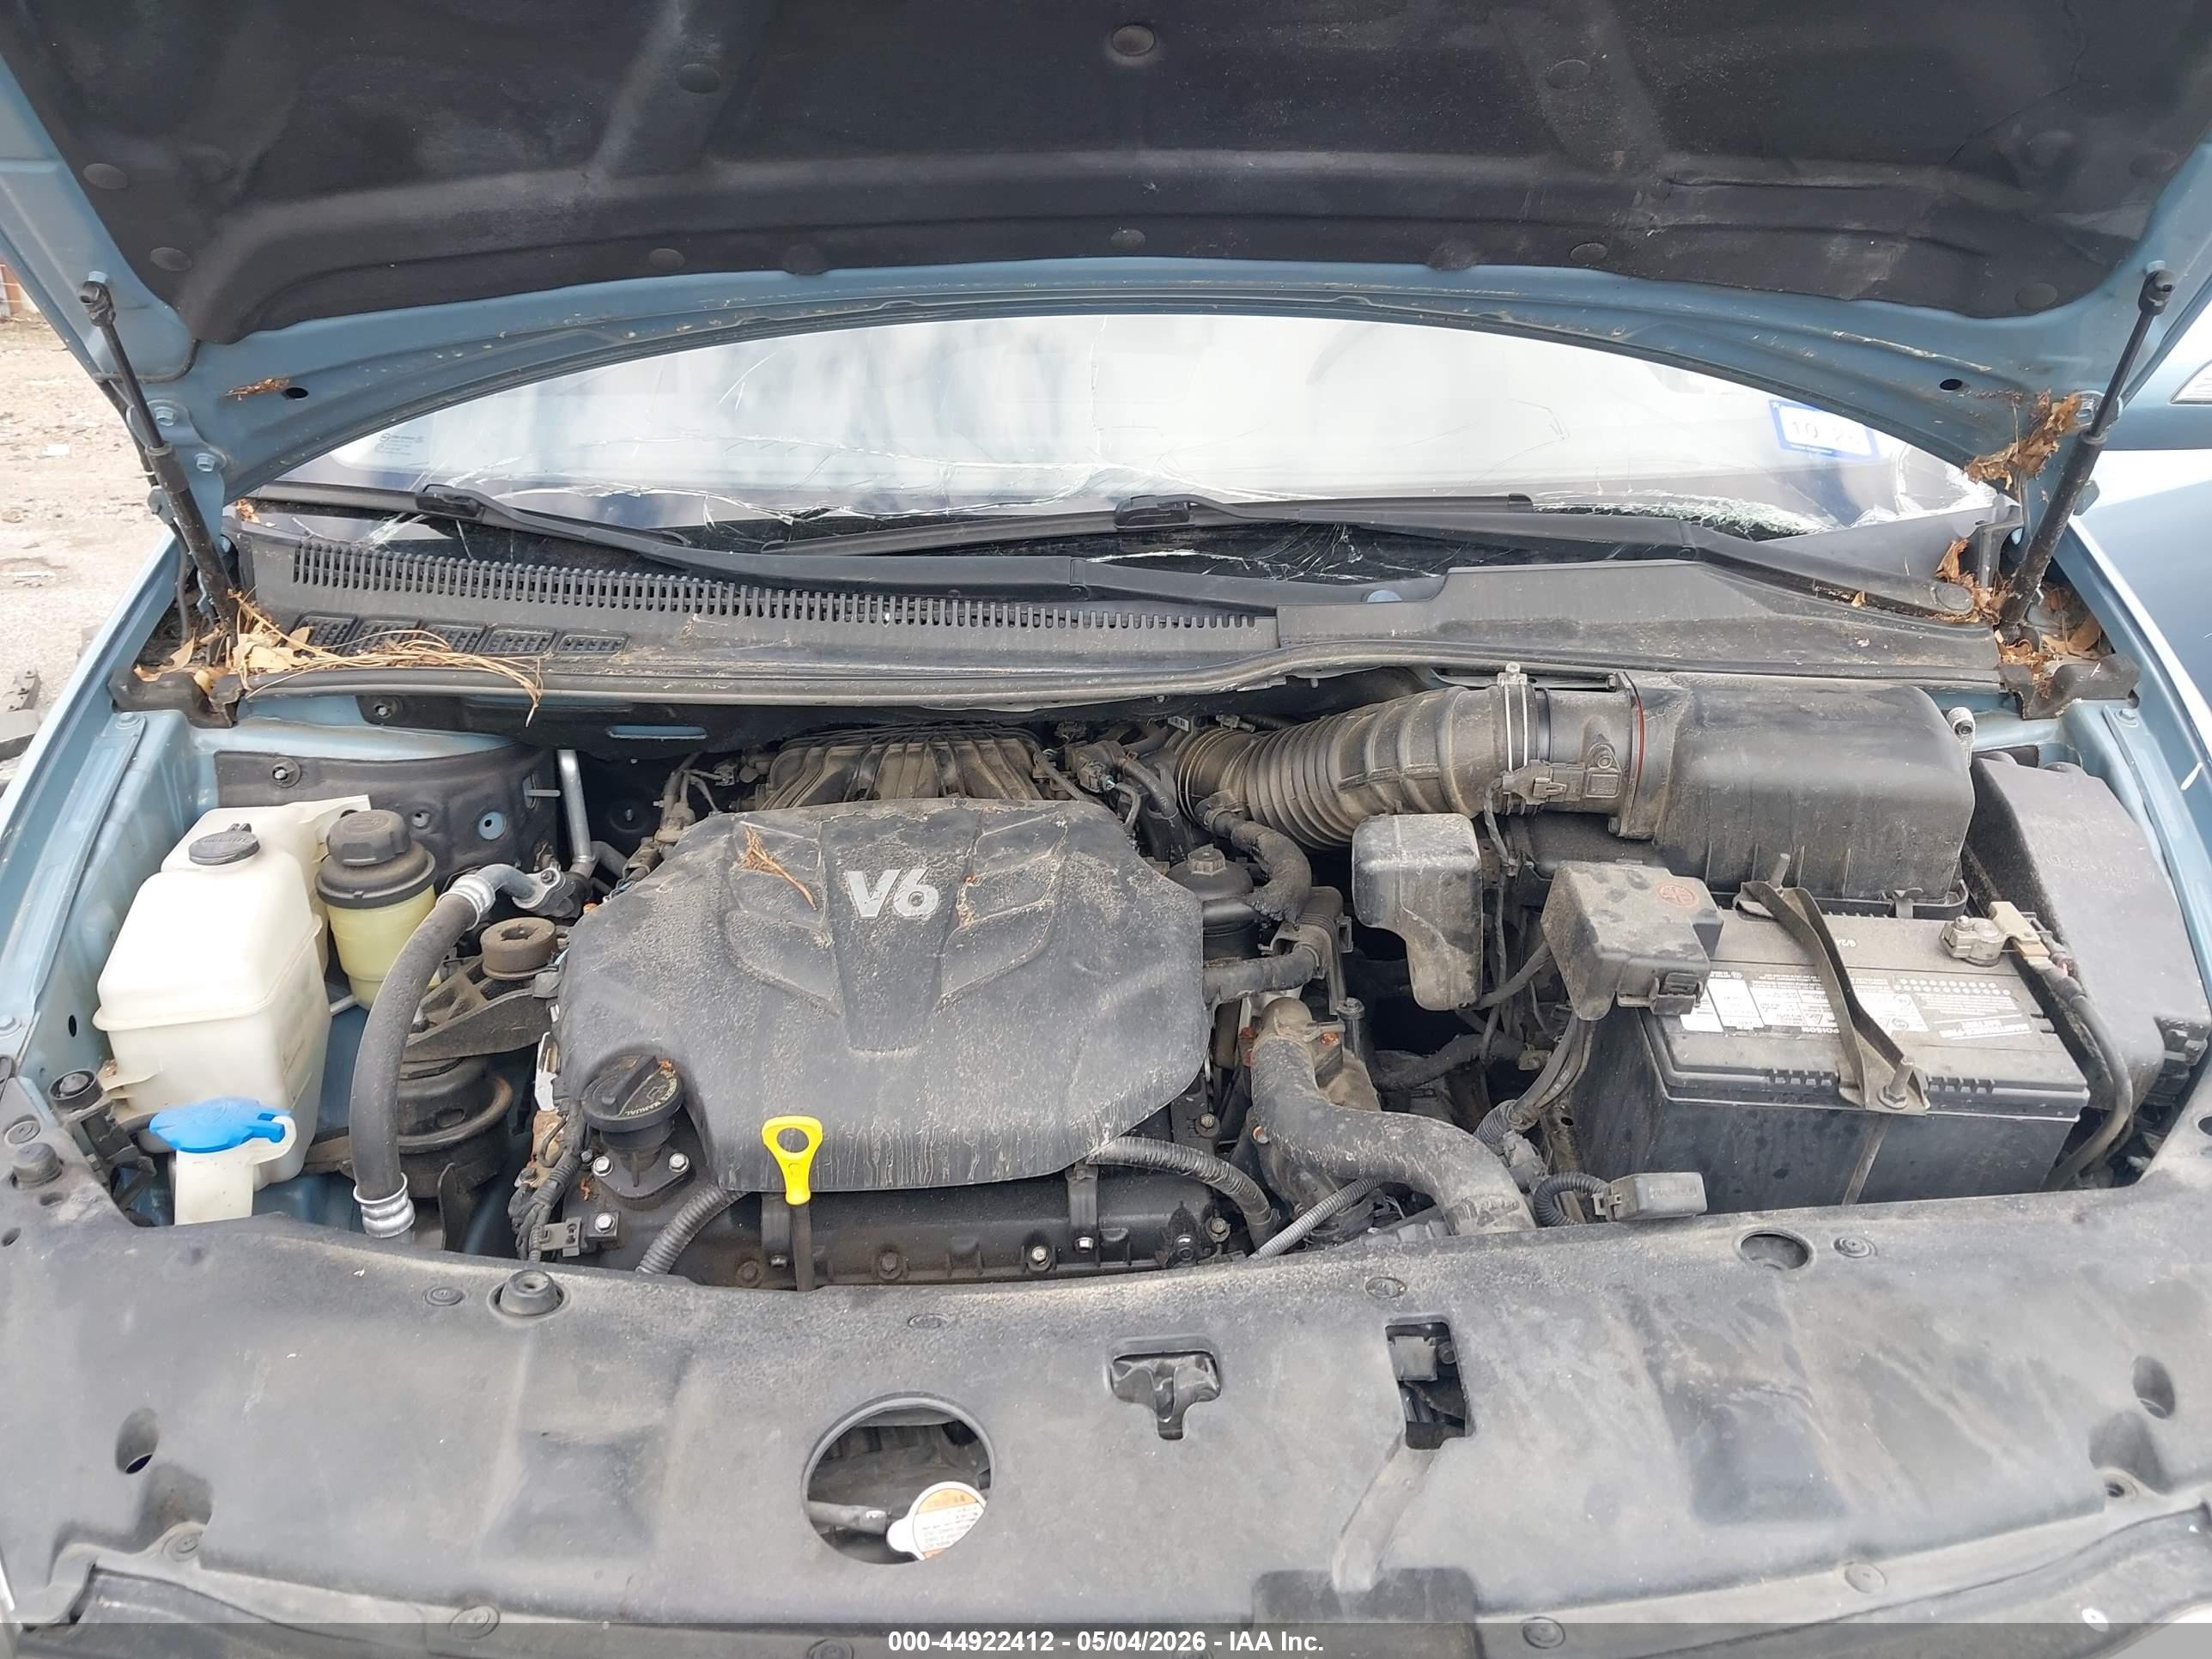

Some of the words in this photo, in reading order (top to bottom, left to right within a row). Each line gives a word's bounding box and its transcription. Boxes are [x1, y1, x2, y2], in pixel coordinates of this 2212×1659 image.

[845, 868, 939, 918] V6
[1801, 1026, 1840, 1035] POISON
[624, 1101, 661, 1116] MANUAL
